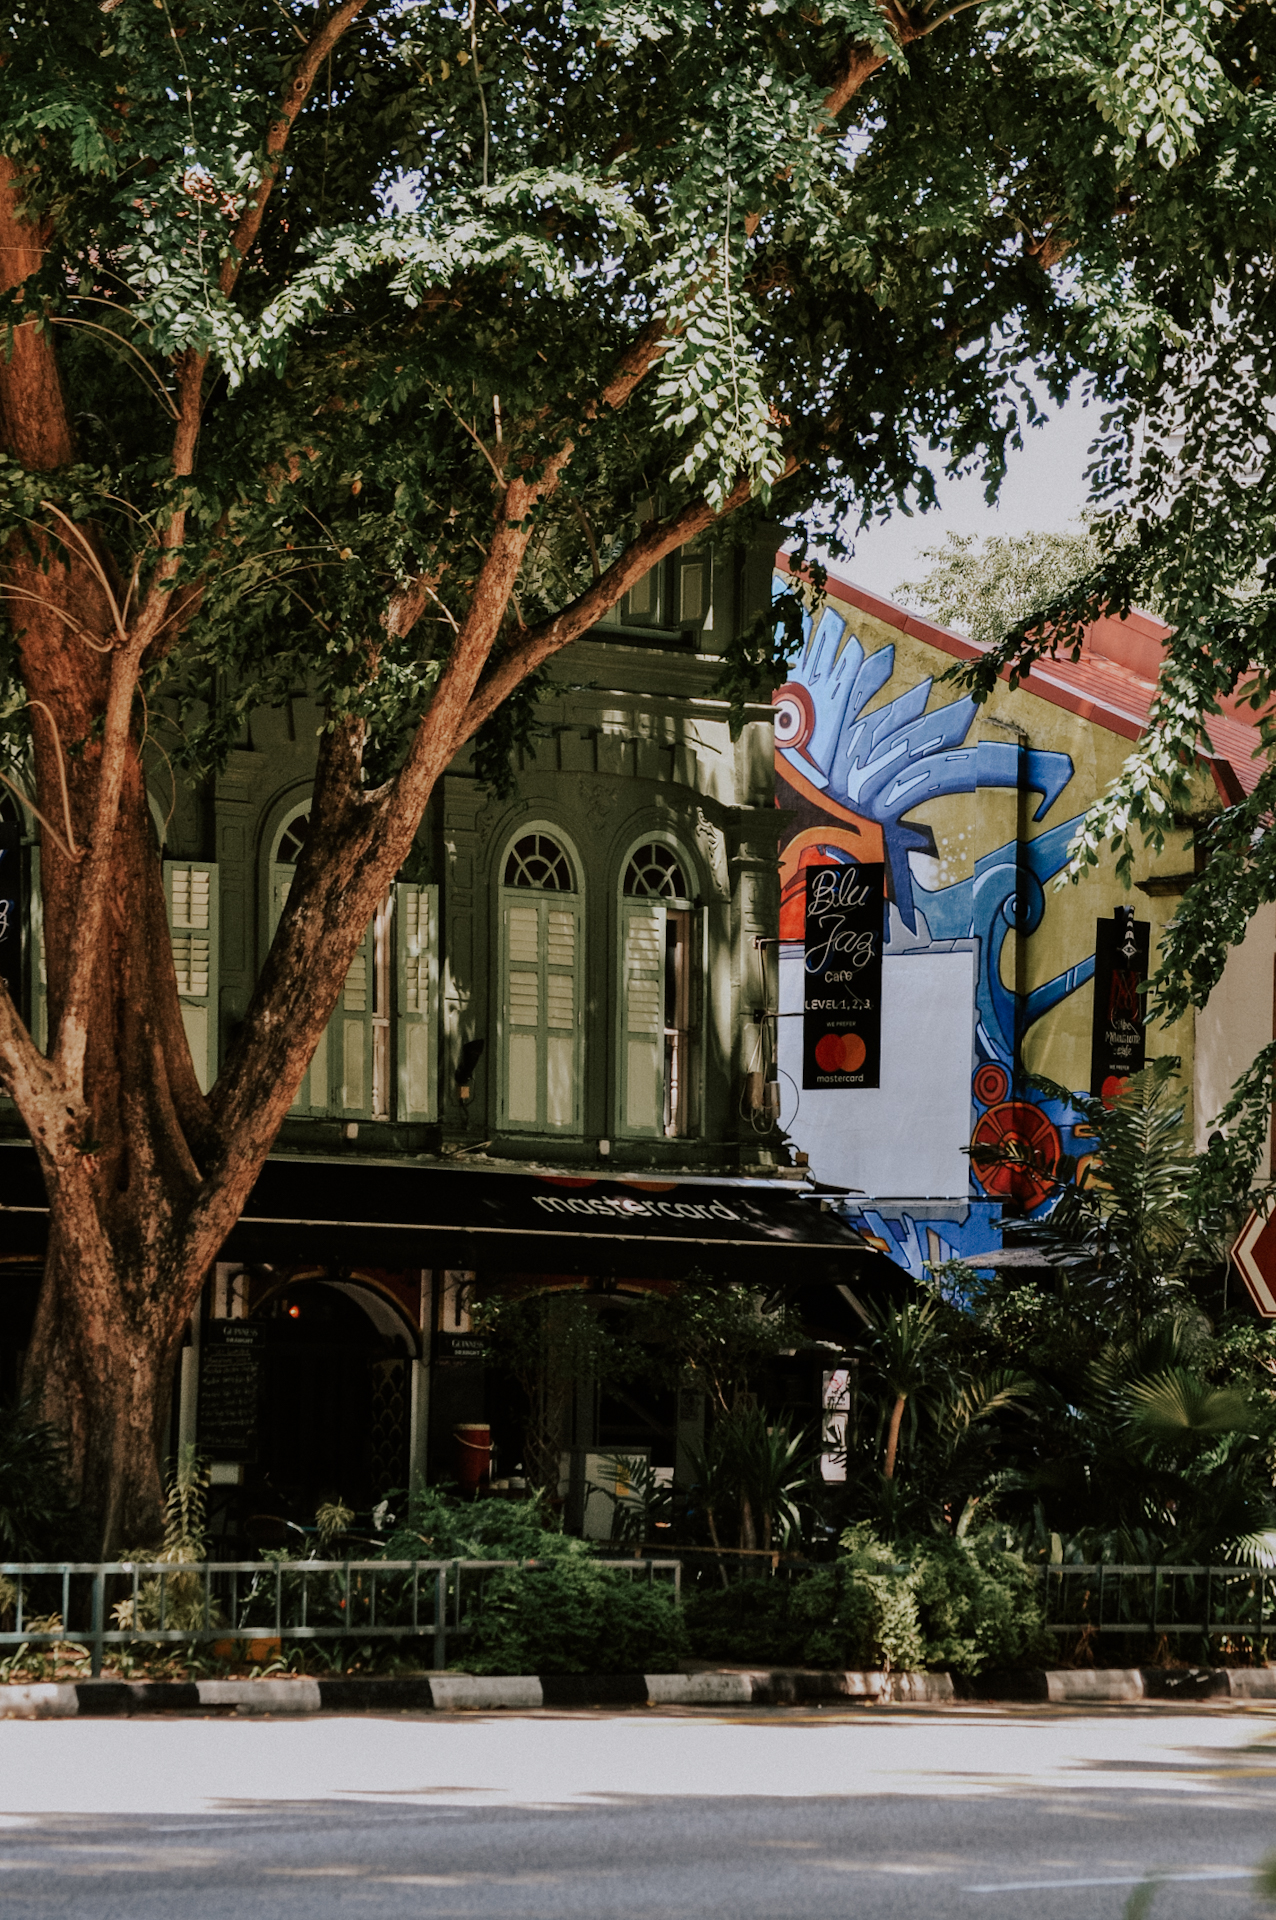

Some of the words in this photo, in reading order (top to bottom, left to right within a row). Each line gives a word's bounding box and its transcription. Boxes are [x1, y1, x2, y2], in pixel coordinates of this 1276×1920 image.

[807, 867, 869, 917] Blu
[804, 914, 875, 973] Jaz
[804, 999, 838, 1010] LEVEL
[816, 1074, 864, 1083] mastercard
[531, 1195, 742, 1221] mastercard
